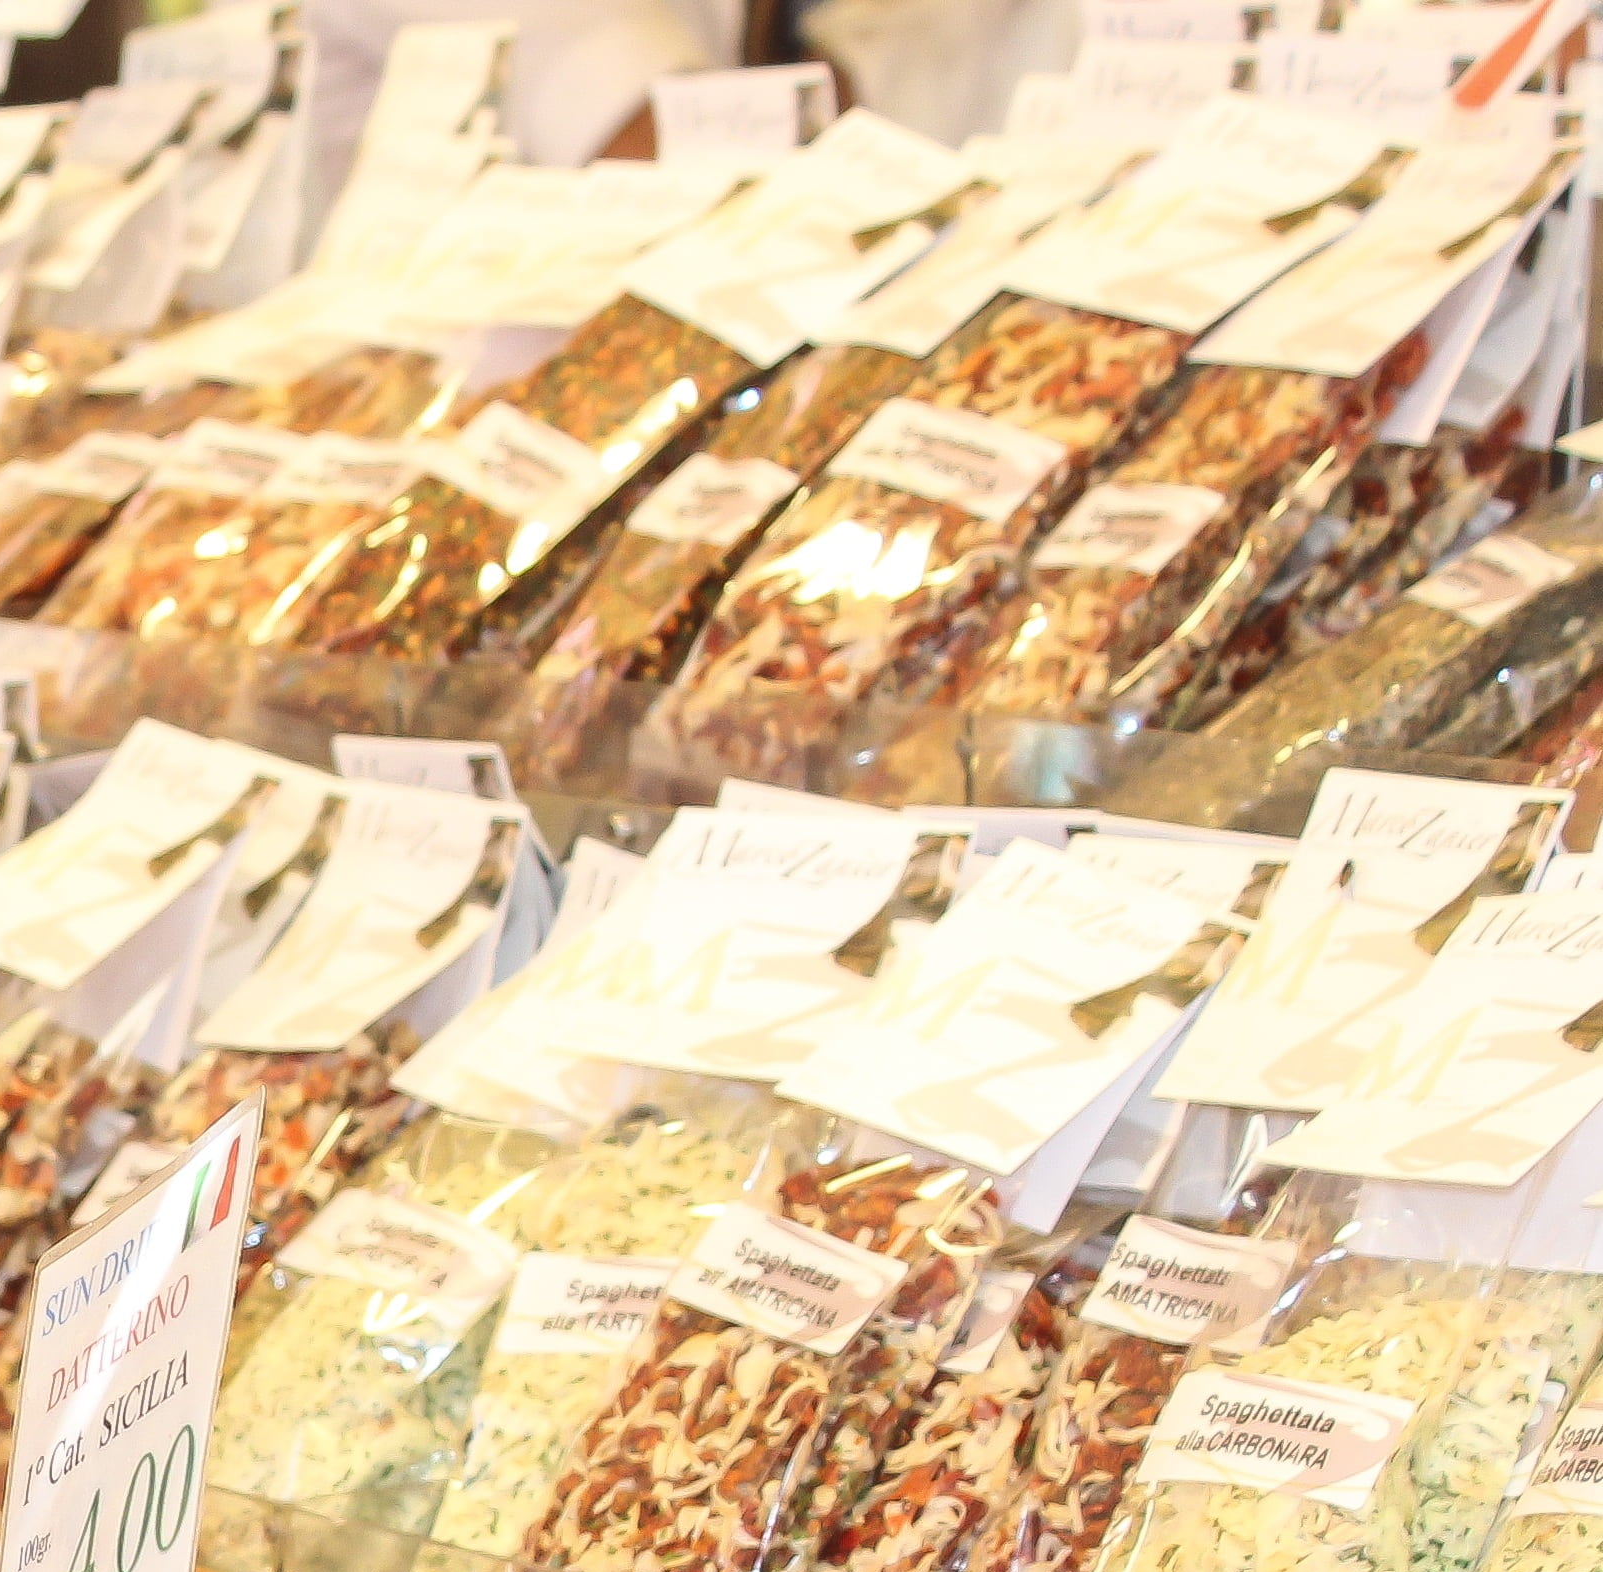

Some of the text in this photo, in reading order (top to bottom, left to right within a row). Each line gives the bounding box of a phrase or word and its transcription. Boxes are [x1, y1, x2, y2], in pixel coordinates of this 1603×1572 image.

[735, 1237, 841, 1292] Spaghettata
[42, 1267, 96, 1337] SUN
[726, 1275, 839, 1328] AMATRICIANA
[1103, 1279, 1240, 1324] AMATRICIANA
[46, 1274, 190, 1413] DATTERINO
[49, 1430, 86, 1485] Cat.
[99, 1350, 189, 1449] SICILIA
[1201, 1394, 1336, 1434] Spaghettata
[1175, 1429, 1330, 1470] alla CARBONARA
